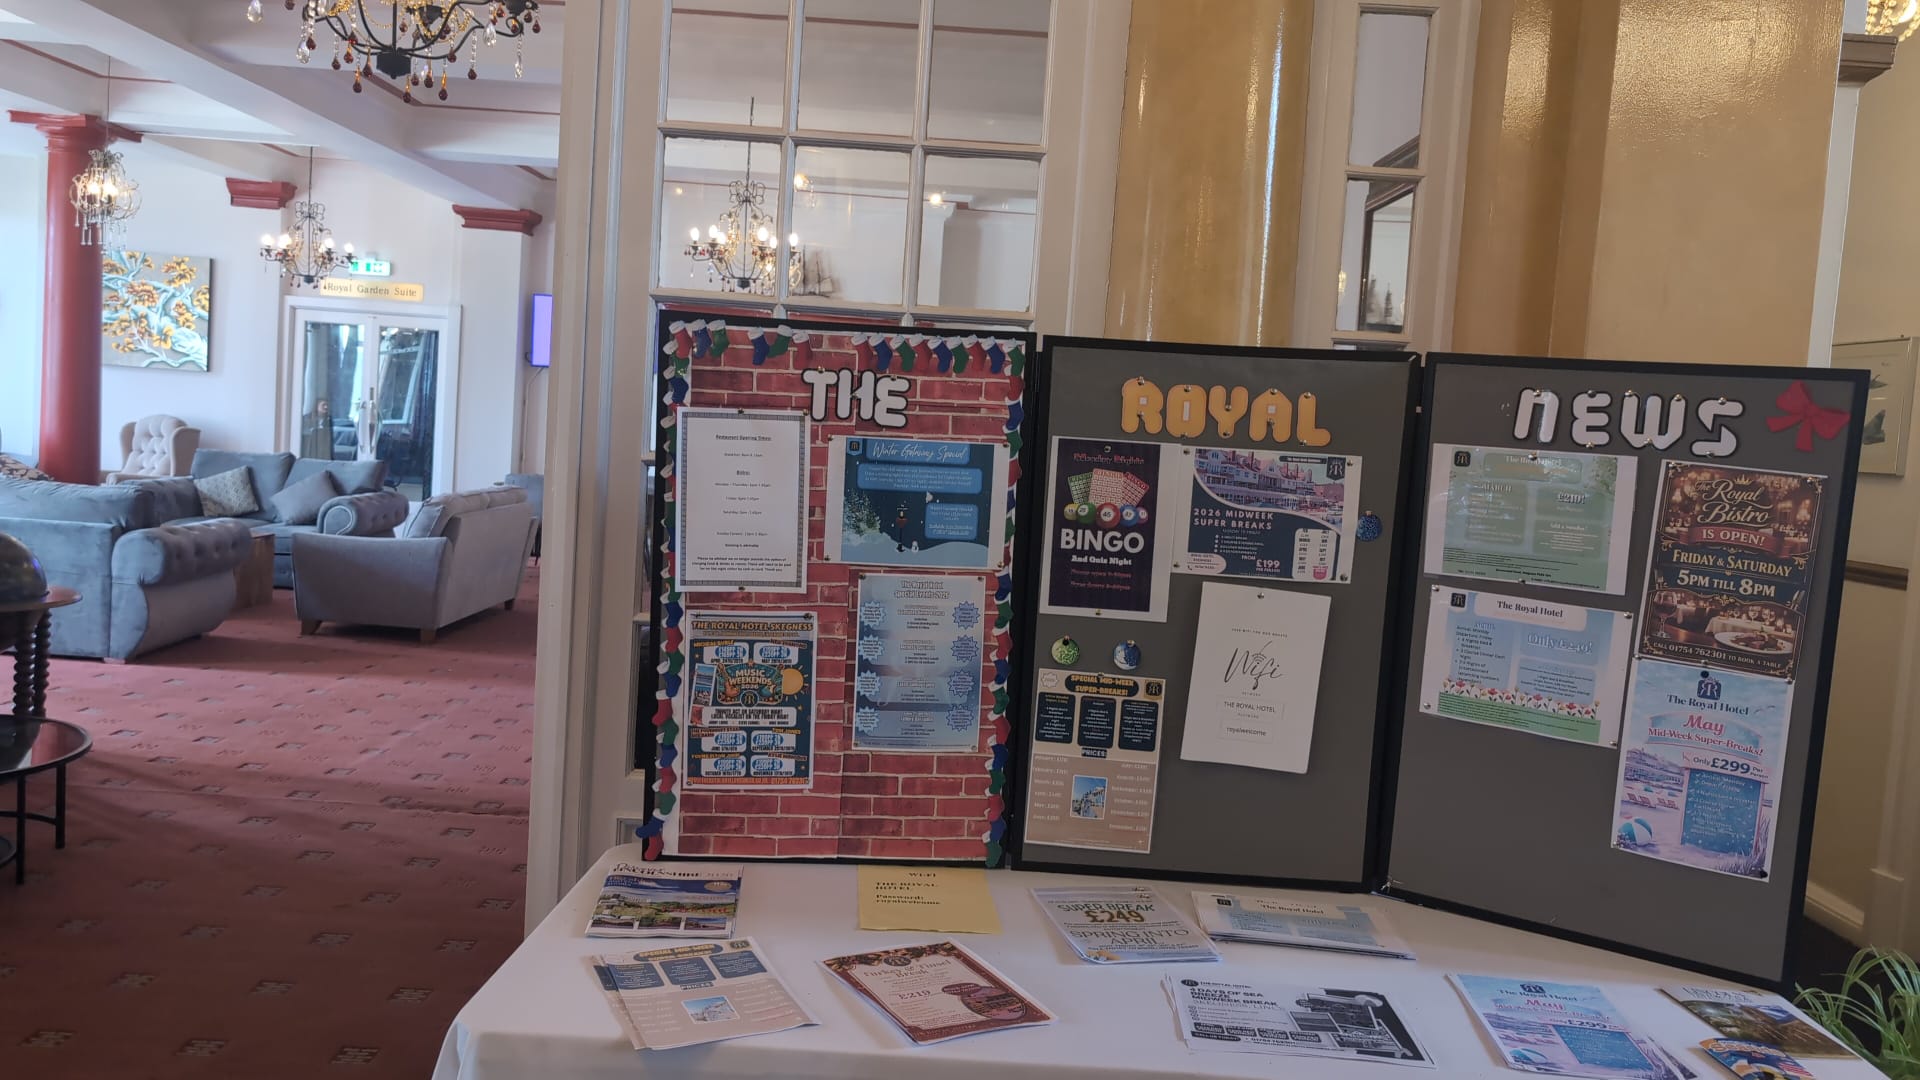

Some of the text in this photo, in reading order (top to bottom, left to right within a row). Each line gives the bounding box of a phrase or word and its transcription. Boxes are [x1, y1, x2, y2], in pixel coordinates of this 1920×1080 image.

[327, 282, 417, 297] Royal Garden Suite
[801, 367, 910, 428] THE
[1121, 376, 1331, 446] ROYAL
[1512, 387, 1744, 458] NEWS
[872, 441, 897, 456] Winter
[1694, 480, 1711, 492] The
[1702, 478, 1768, 508] Royal
[1193, 508, 1274, 520] 2026 MIDWEEK
[1697, 502, 1769, 526] Bistro
[1193, 518, 1272, 530] SUPER BREAKS
[1060, 528, 1145, 554] BINGO
[1702, 528, 1766, 546] IS OPEN!
[1071, 555, 1088, 563] And
[1109, 557, 1132, 566] Night
[1256, 559, 1281, 569] £199
[1672, 550, 1793, 577] FRIDAY & SATURDAY
[1677, 570, 1776, 597] 5PM TILL 8PM
[1497, 600, 1563, 618] The Royal Hotel
[691, 621, 813, 631] THE ROYAL HOTEL SKEGNESS
[1527, 632, 1559, 648] Only
[1653, 642, 1668, 650] CALL
[1668, 644, 1693, 655] 01754
[736, 668, 765, 677] MUSIC
[1224, 646, 1284, 690] Wifi
[729, 676, 772, 686] WEEKENDS
[1070, 674, 1098, 683] SPECIAL
[1236, 702, 1256, 711] ROYAL
[1257, 705, 1276, 713] HOTEL
[1667, 694, 1750, 716] The Royal Hotel
[1683, 714, 1725, 736] May
[1648, 727, 1764, 757] Mid-Week Super-Breaks!
[1082, 749, 1106, 757] PRICES
[1693, 756, 1751, 774] Only £299
[1058, 903, 1155, 912] SUPER BREAK
[1085, 910, 1145, 923] £249
[1070, 929, 1190, 938] SPRING INTO
[1110, 937, 1158, 945] APRIL
[863, 968, 901, 977] Turkey
[919, 959, 952, 969] Tinsel
[895, 970, 929, 978] Break
[1191, 995, 1241, 1003] MIDWEEK
[1518, 990, 1548, 999] Royal
[1526, 999, 1566, 1011] May
[1567, 1019, 1607, 1029] £299
